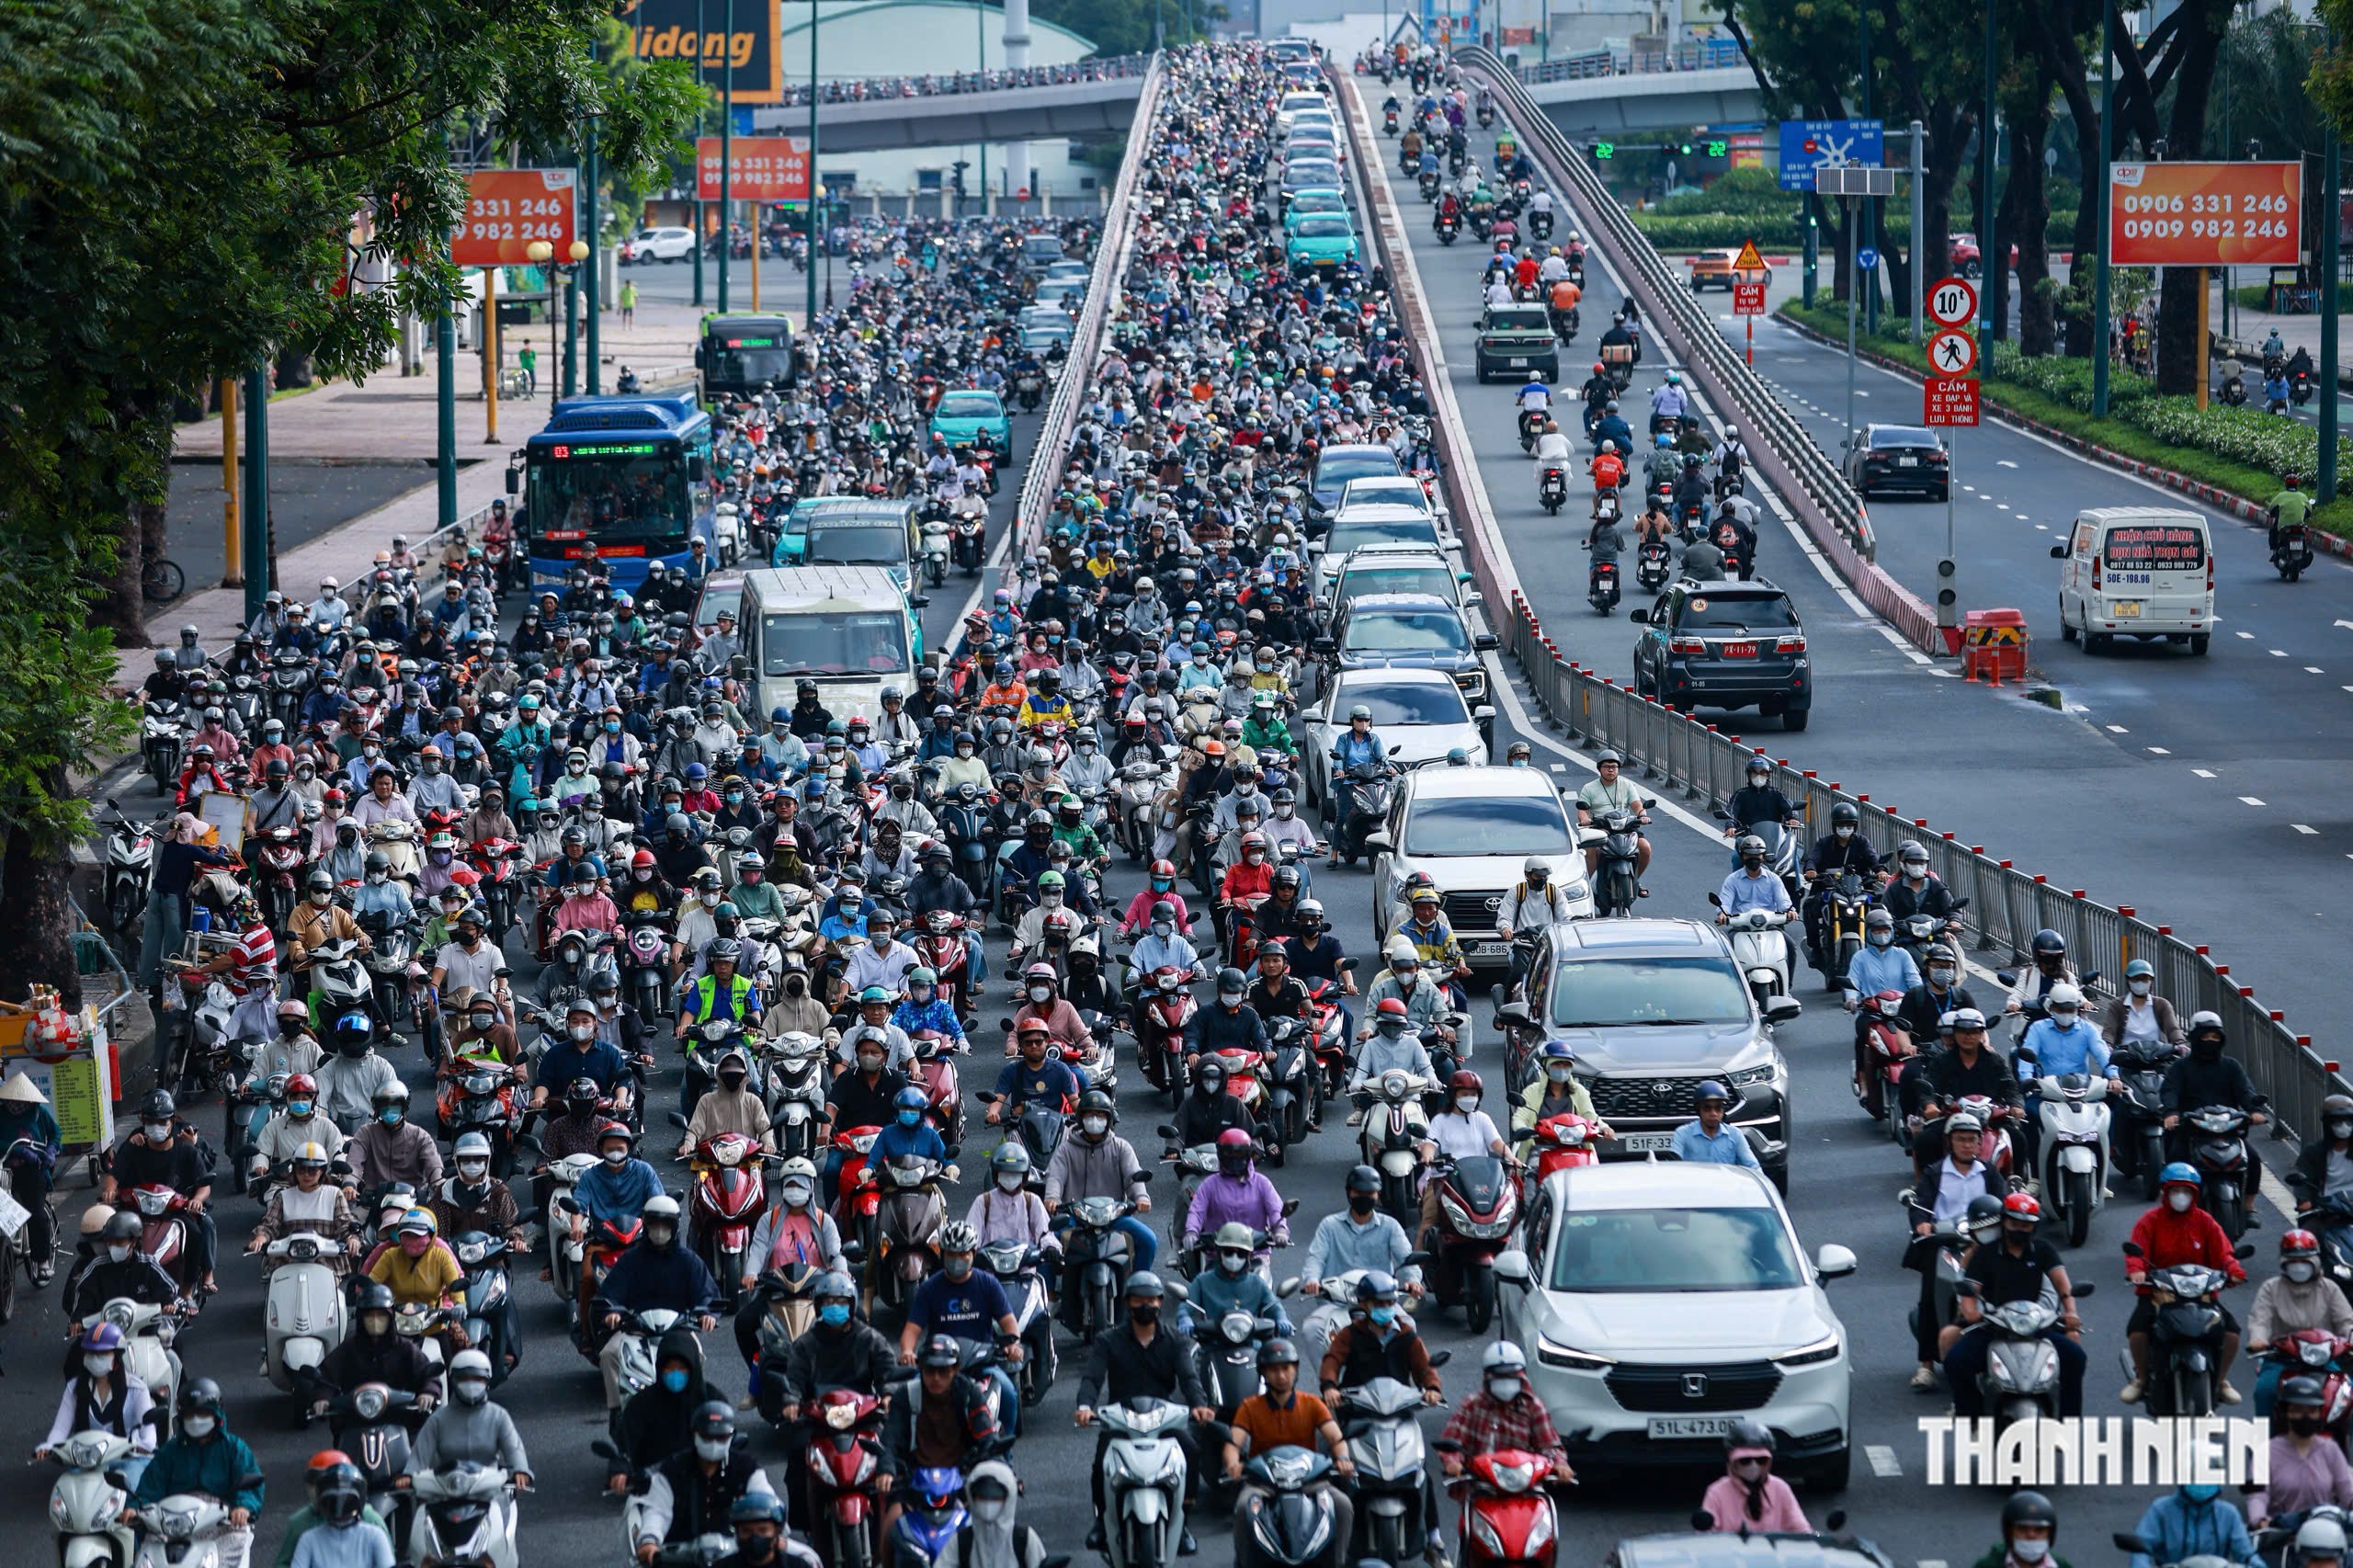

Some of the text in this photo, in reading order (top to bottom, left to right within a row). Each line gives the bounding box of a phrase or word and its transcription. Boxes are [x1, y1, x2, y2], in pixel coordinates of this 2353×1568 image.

[703, 157, 803, 169] 096 331 246
[703, 172, 804, 184] 099 982 246
[472, 199, 562, 217] 331 246
[2124, 195, 2288, 213] 0906 331 246
[472, 222, 514, 239] 982
[521, 222, 563, 239] 246
[2124, 220, 2288, 238] 0909 982 246
[1938, 291, 1958, 314] 10
[1938, 379, 1967, 392] CẤM
[1932, 393, 1942, 402] XE
[1932, 403, 1942, 412] XE
[1953, 403, 1972, 413] BÁNH
[1950, 414, 1973, 424] THÔNG
[2114, 528, 2143, 543] NHẬN
[2143, 528, 2165, 542] CHỞ
[2166, 528, 2194, 541] HÀNG
[2132, 545, 2153, 558] NHÀ
[2154, 546, 2180, 560] TRỌN
[2181, 545, 2199, 558] GÓI
[1631, 1138, 1672, 1149] 51F-33
